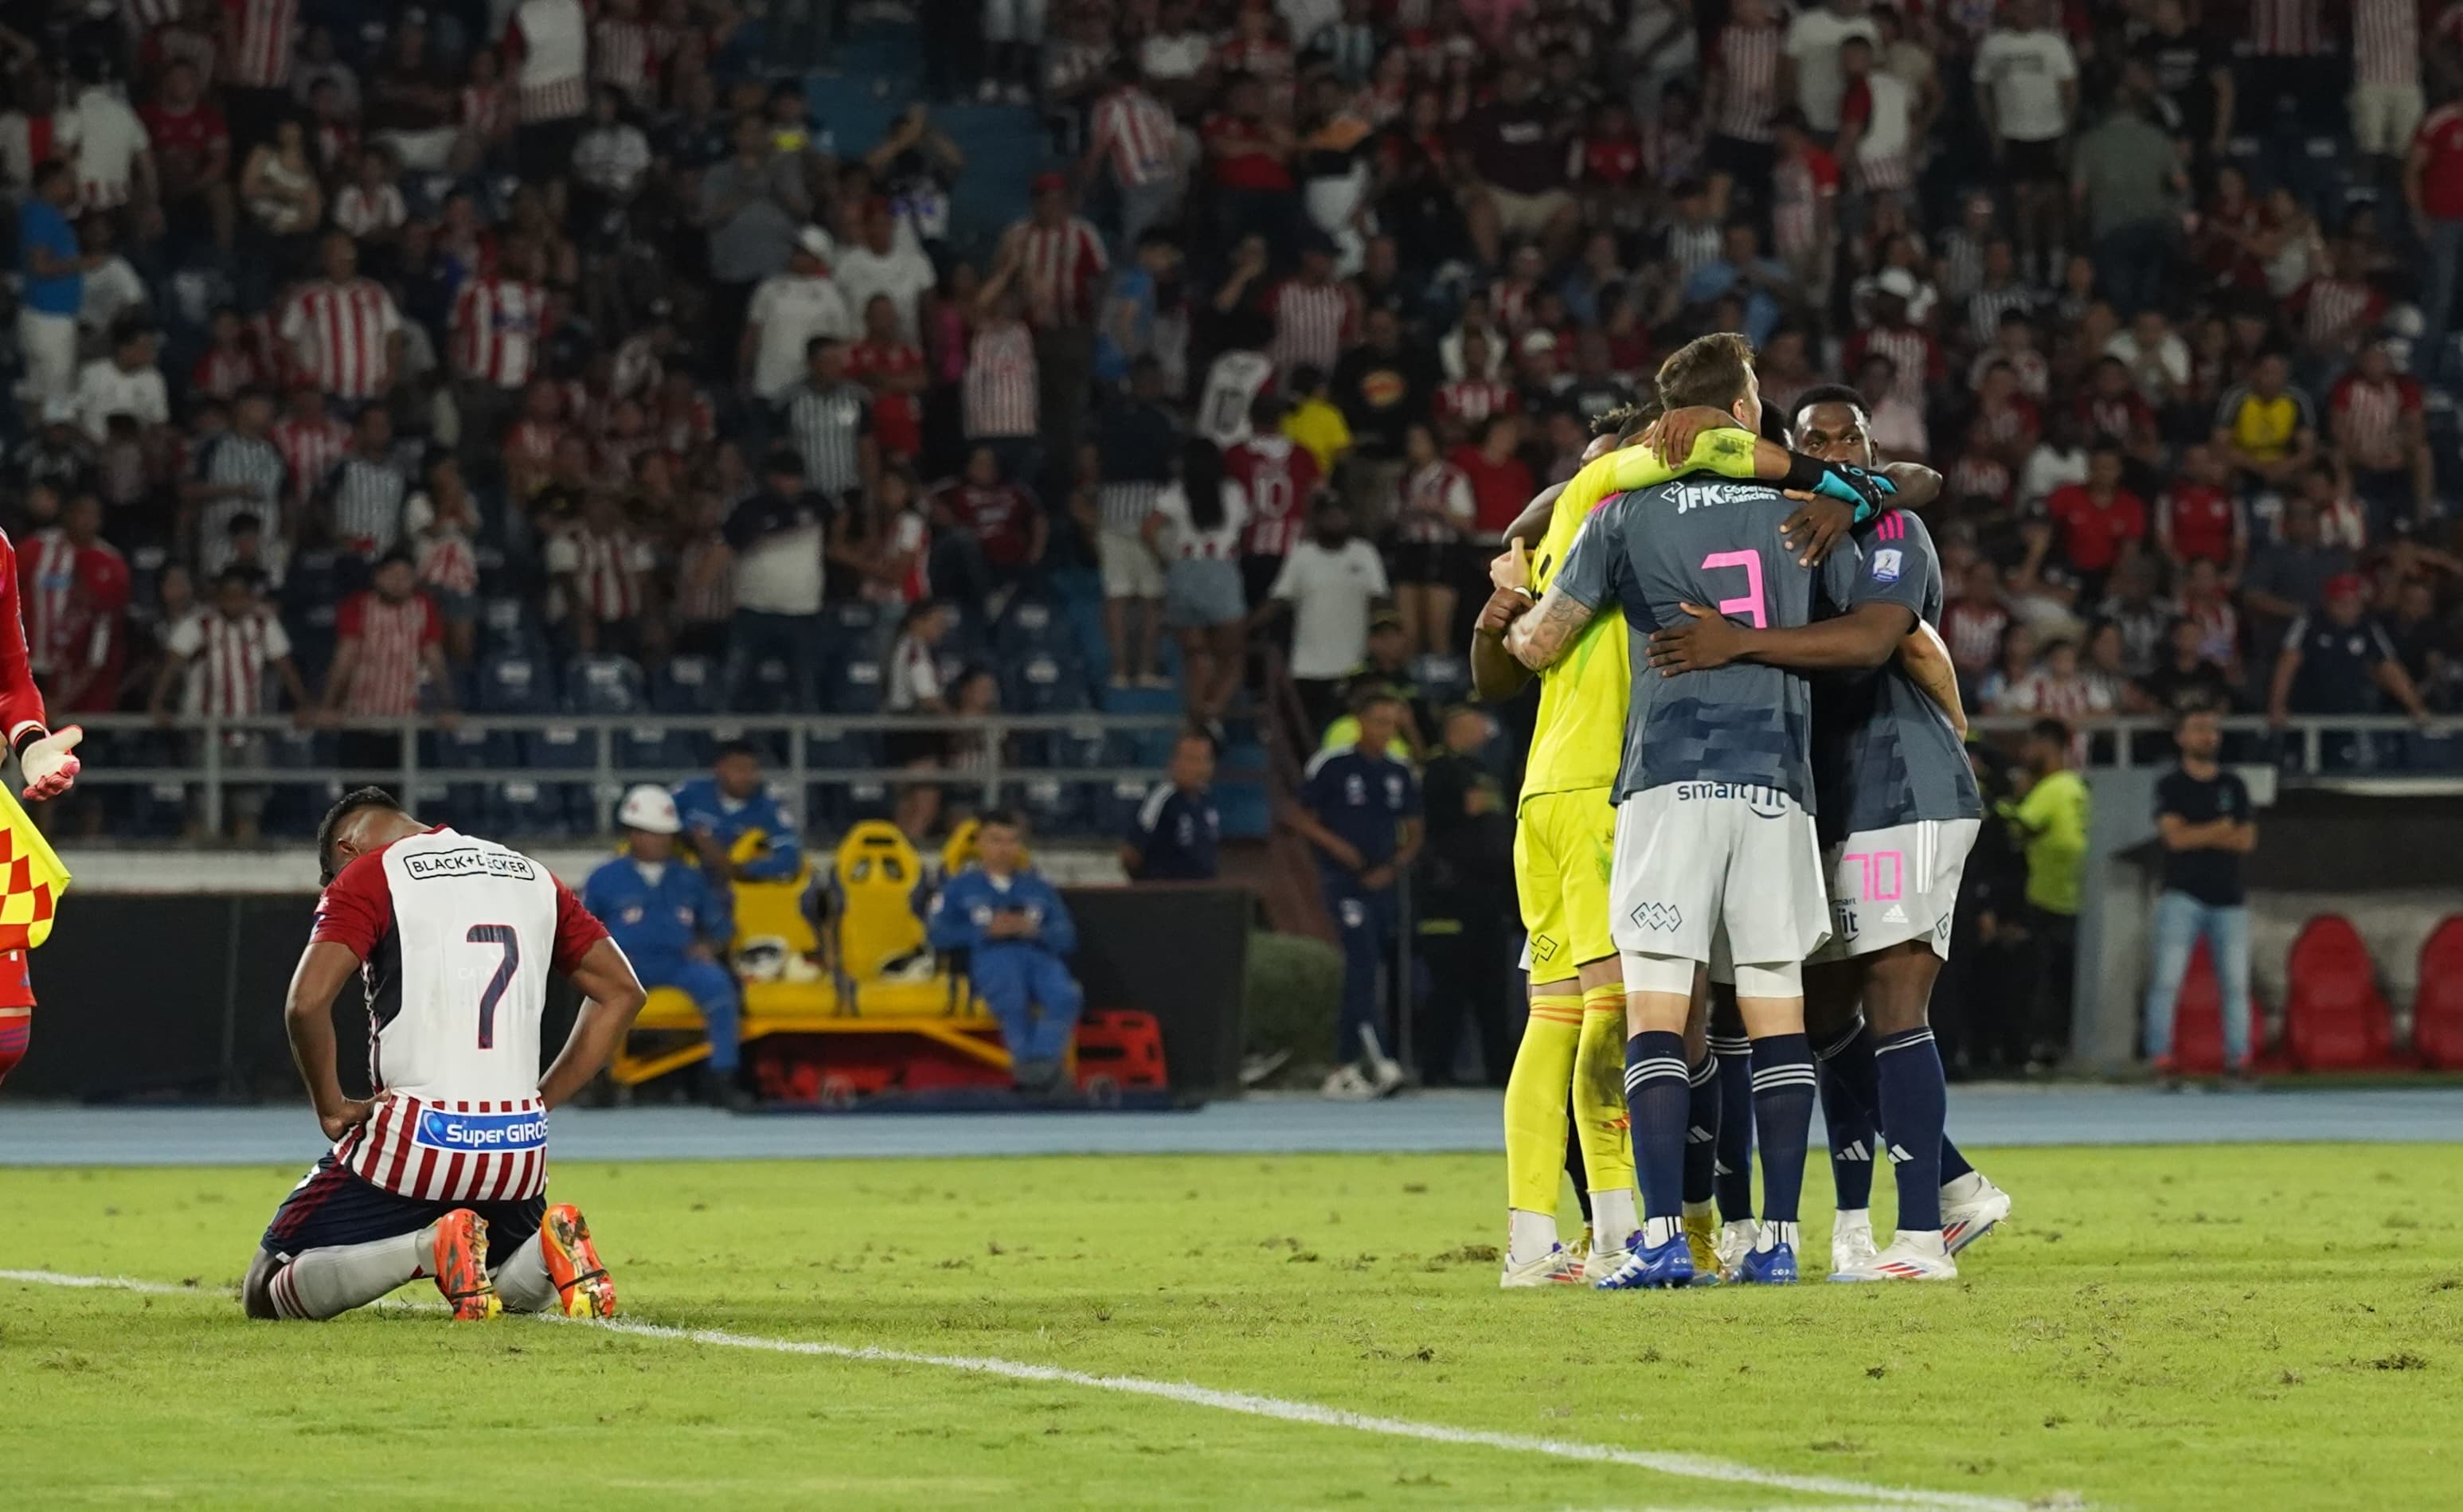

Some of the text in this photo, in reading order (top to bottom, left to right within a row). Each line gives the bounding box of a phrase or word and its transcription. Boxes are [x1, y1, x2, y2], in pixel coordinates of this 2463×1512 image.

[1677, 484, 1726, 514] JFK
[1701, 549, 1767, 629] 3
[1677, 783, 1746, 801] smart
[467, 924, 519, 1049] 7
